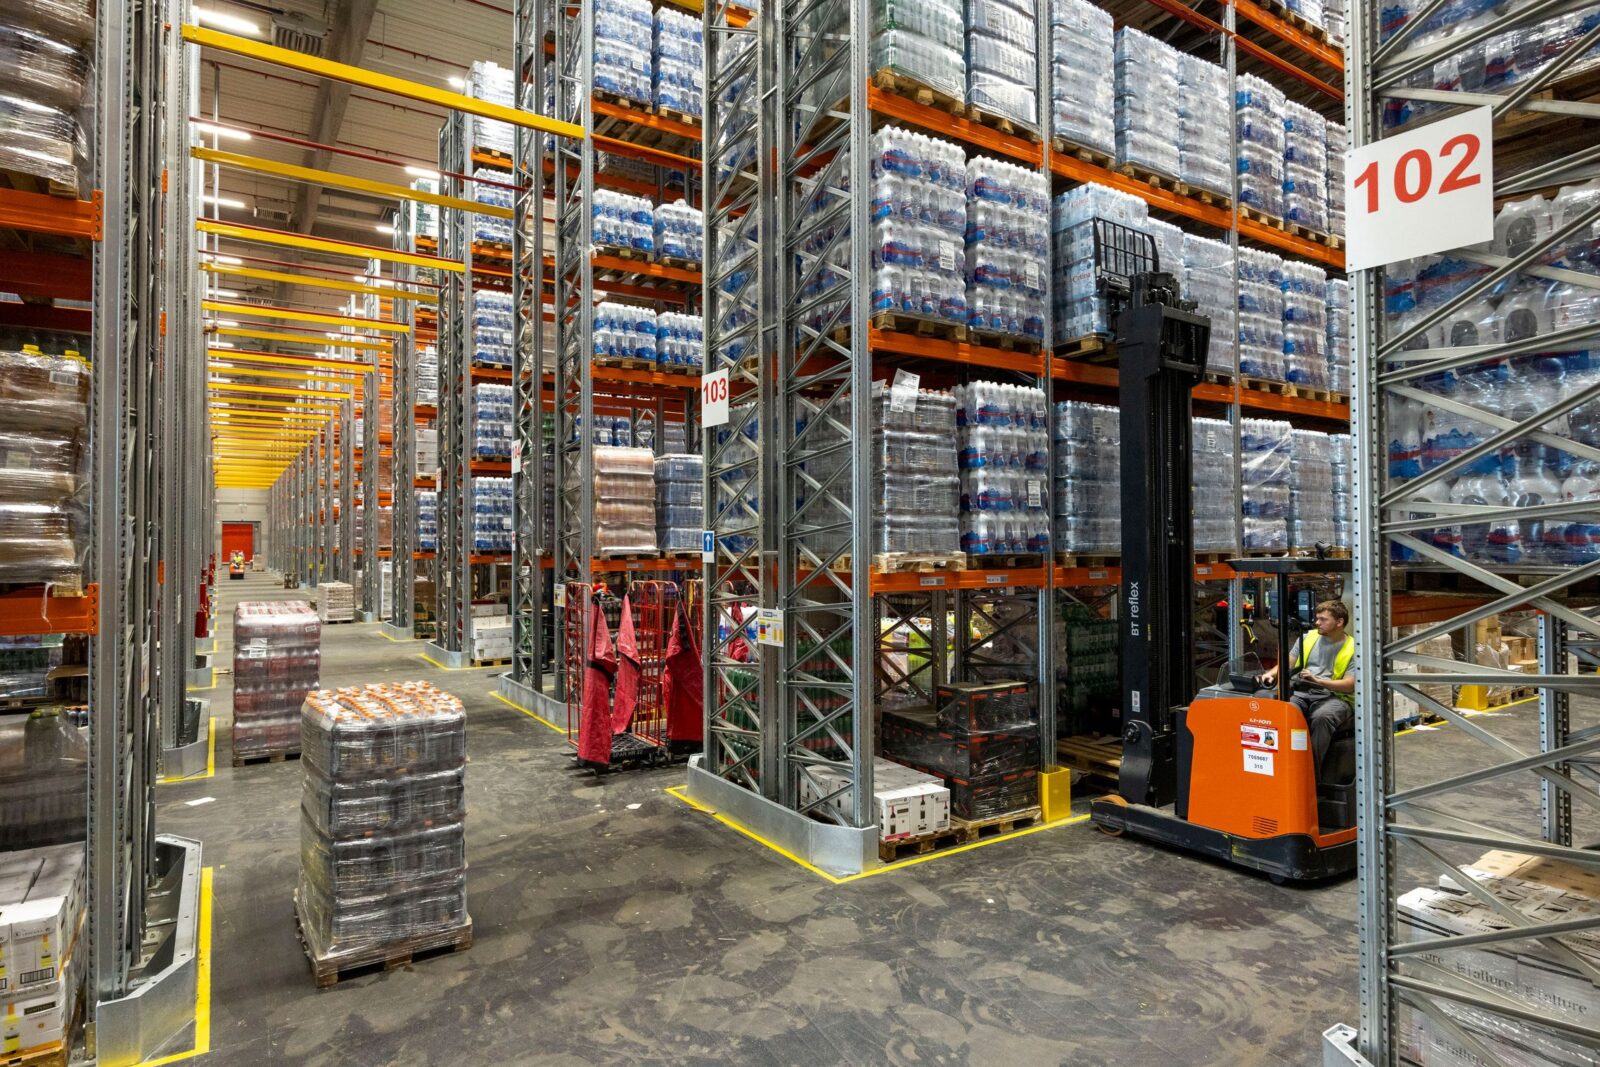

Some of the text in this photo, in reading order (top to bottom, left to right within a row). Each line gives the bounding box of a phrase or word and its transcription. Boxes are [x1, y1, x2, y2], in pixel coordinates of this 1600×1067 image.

[1354, 133, 1481, 214] 102
[703, 377, 727, 405] 103
[1128, 581, 1140, 636] BT reflex
[1473, 966, 1513, 989] allure
